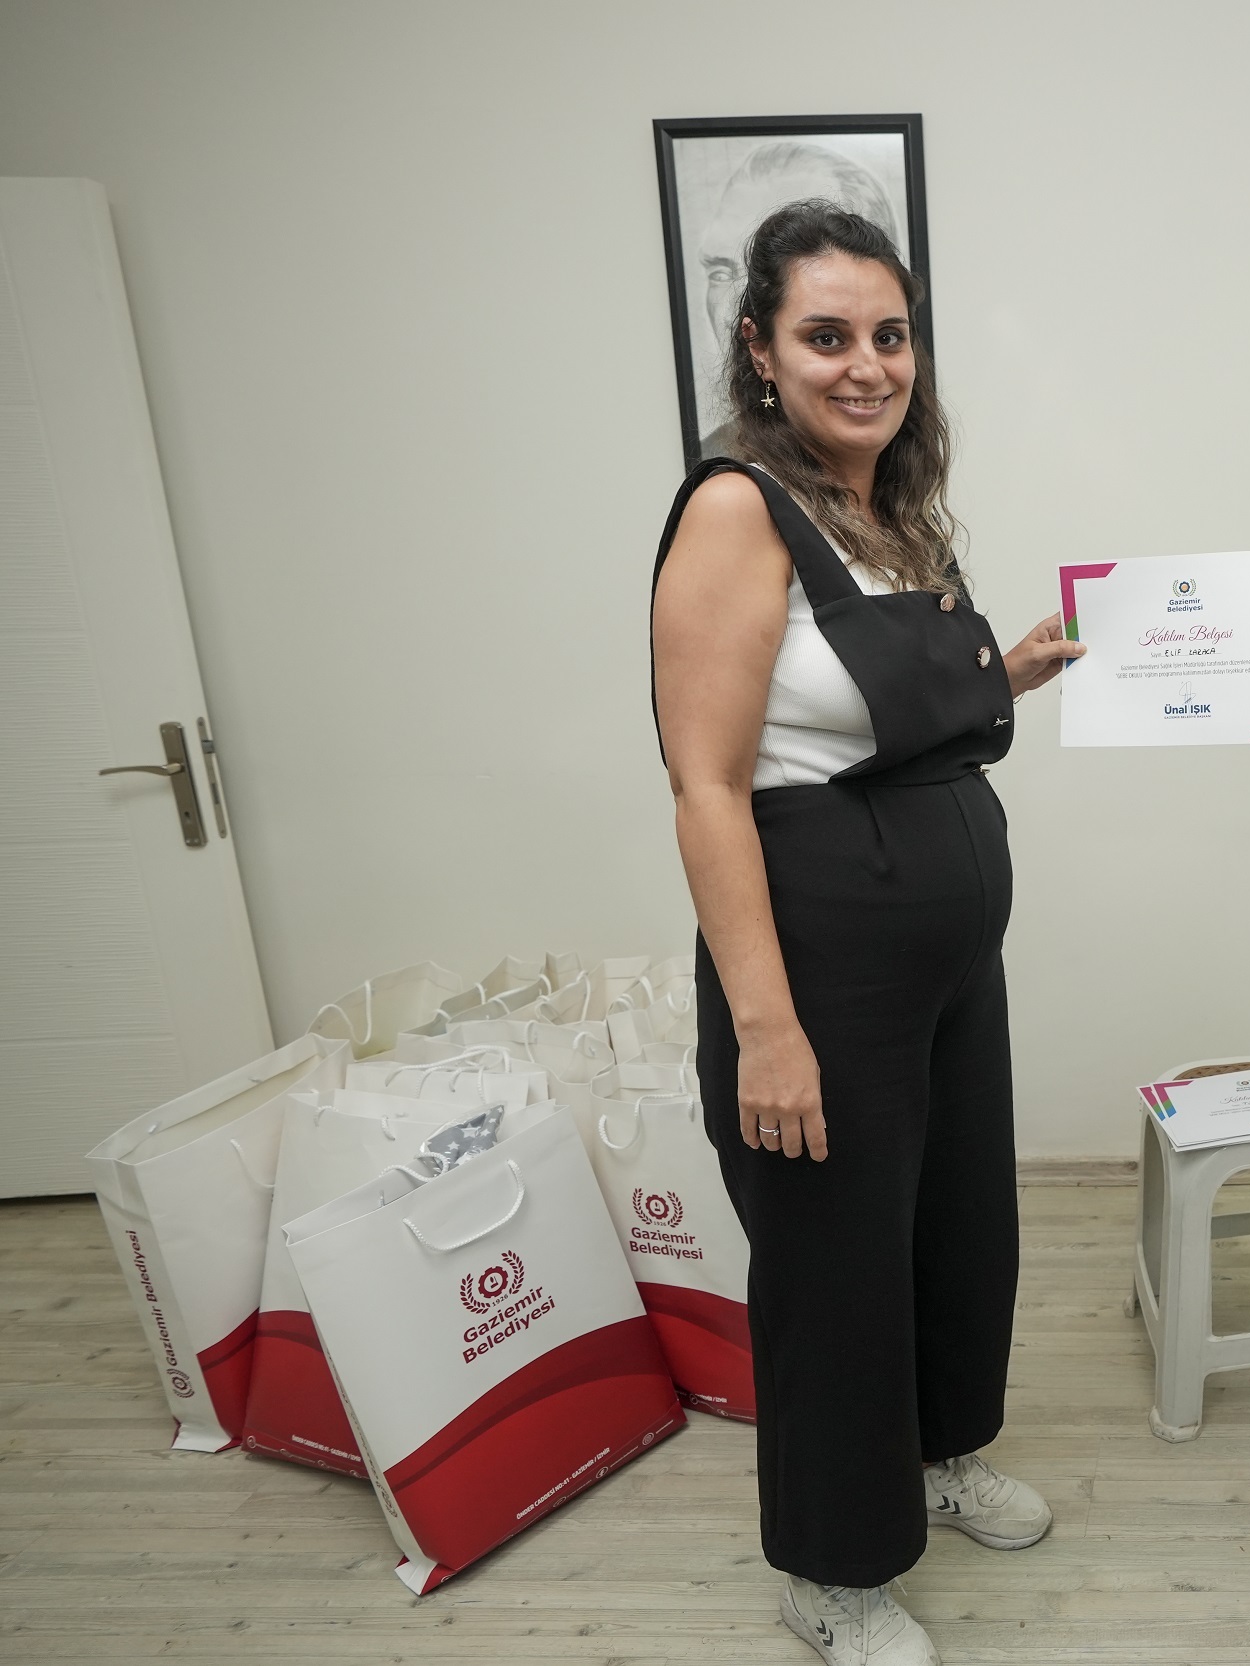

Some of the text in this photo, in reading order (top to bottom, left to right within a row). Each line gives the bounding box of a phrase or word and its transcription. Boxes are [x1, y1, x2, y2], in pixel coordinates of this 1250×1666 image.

[1167, 604, 1203, 613] Belediyesi
[1169, 598, 1201, 606] Gaziemir
[1189, 625, 1233, 644] Belgesi
[1164, 703, 1211, 715] Ünal IŞIK
[631, 1227, 696, 1245] Gaziemir
[629, 1240, 703, 1260] Belediyesi
[125, 1229, 178, 1367] Gaziemir Belediyesi
[492, 1293, 509, 1308] 1926
[463, 1286, 543, 1343] Gaziemir
[462, 1295, 556, 1364] Belediyesi
